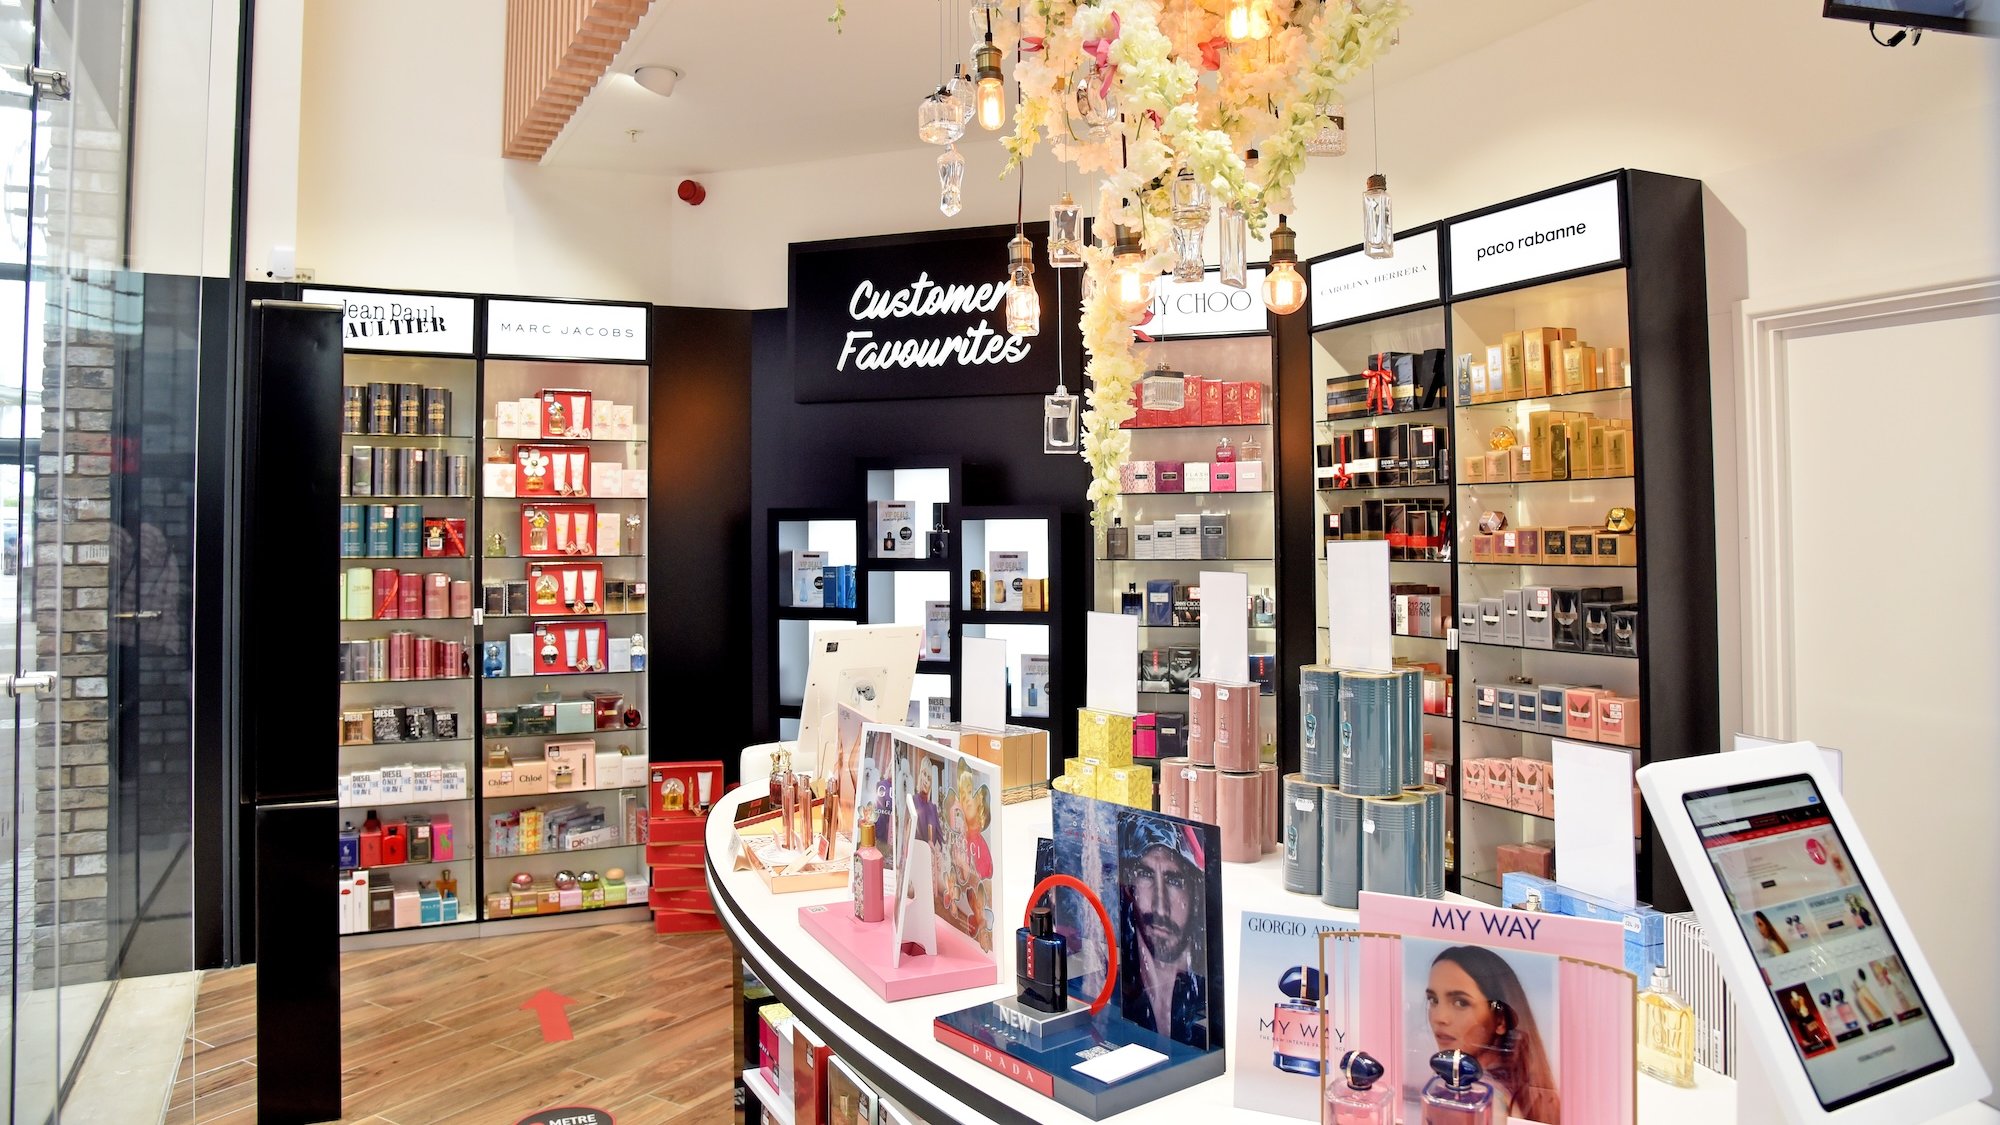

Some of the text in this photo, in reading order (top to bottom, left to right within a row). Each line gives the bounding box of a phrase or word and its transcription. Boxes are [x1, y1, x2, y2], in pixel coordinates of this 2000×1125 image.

[1476, 221, 1587, 261] paco rabanne
[1320, 263, 1428, 297] CAROLINA HERRERA
[849, 271, 1011, 321] Customer
[1176, 290, 1252, 315] CHOO
[342, 299, 436, 322] Jean Paul
[344, 316, 447, 338] AULTIER
[499, 323, 635, 338] MARC JACOBS
[836, 319, 1032, 373] Favourites
[1419, 602, 1430, 611] 212
[374, 709, 395, 718] DIESEL
[382, 770, 403, 778] DIESEL
[519, 774, 542, 783] Chloé
[571, 834, 601, 848] DKNY
[1248, 917, 1307, 937] GIORGIO
[1431, 906, 1542, 942] MY WAY
[999, 1005, 1032, 1033] NEW
[1259, 1017, 1291, 1035] MY
[971, 1043, 1035, 1083] PRADA
[548, 1113, 598, 1125] METRE
